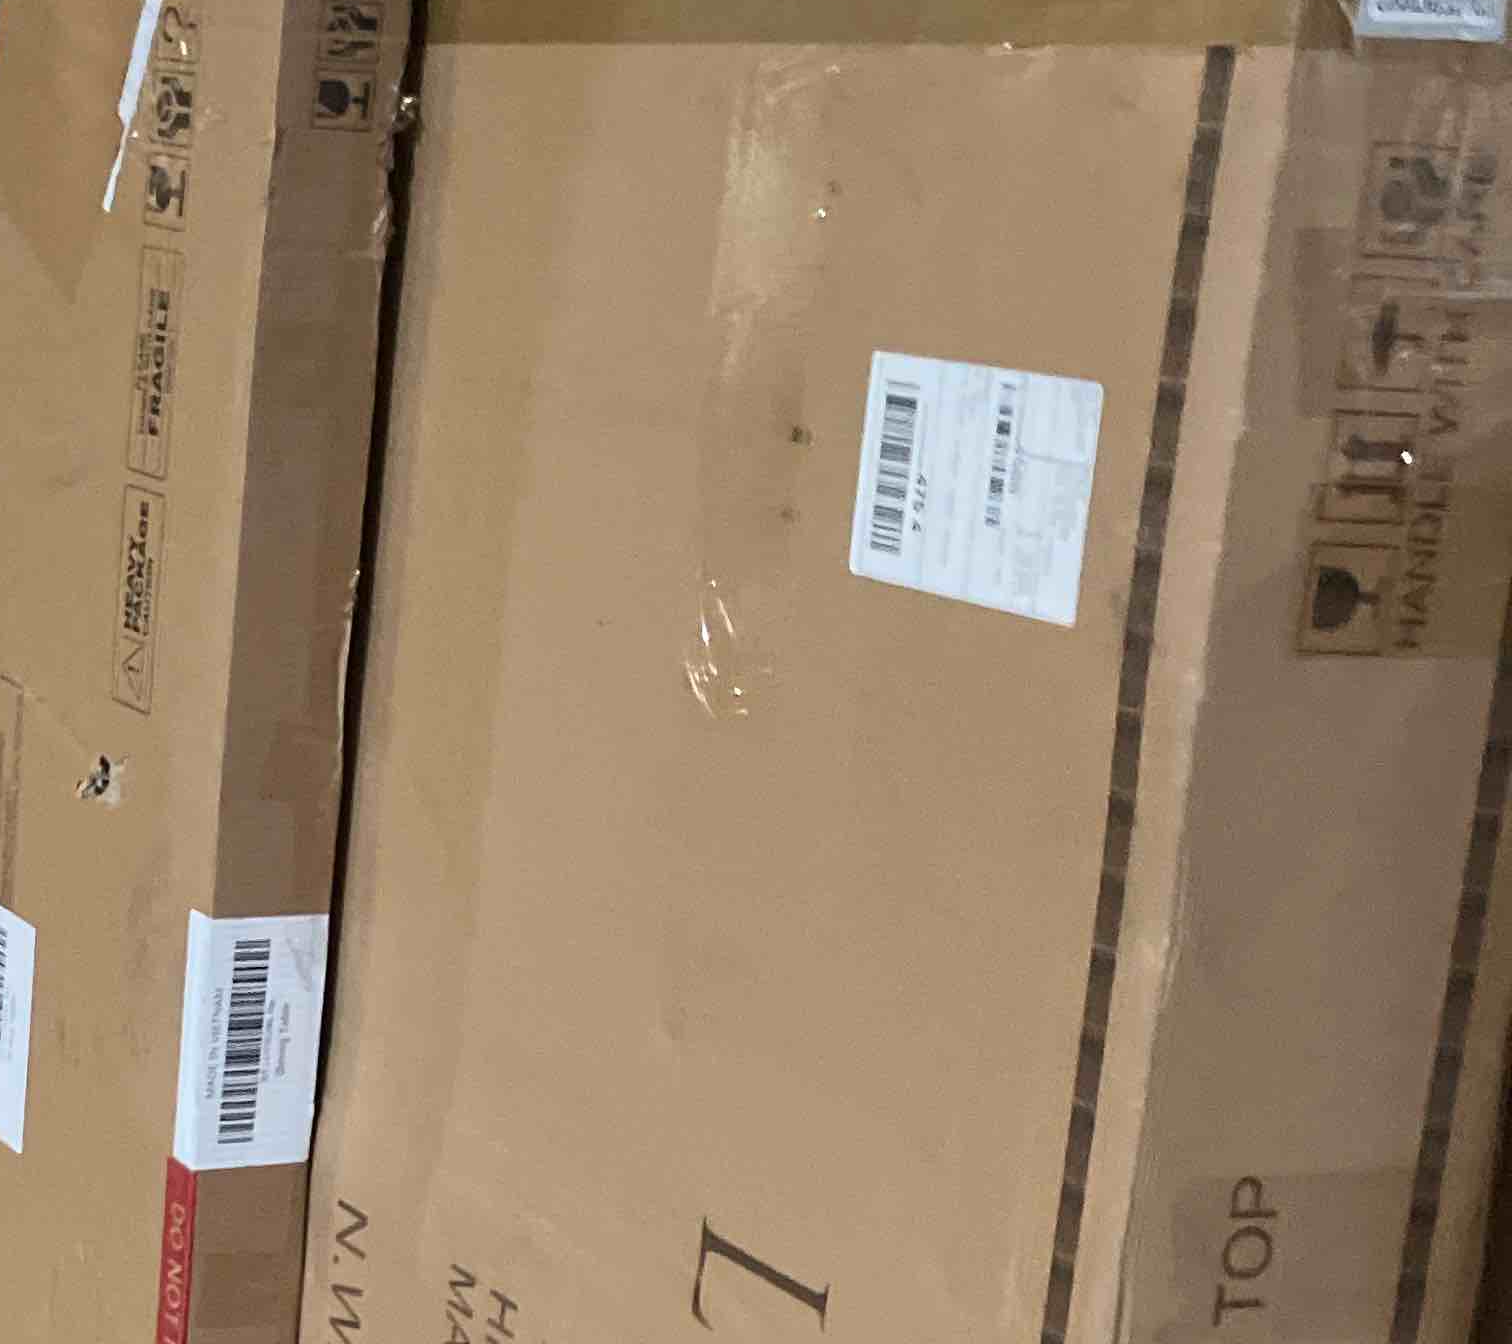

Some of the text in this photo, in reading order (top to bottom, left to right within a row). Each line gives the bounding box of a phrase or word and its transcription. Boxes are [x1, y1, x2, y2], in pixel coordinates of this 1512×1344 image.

[147, 288, 170, 437] FRAGILE
[123, 534, 137, 630] HEAVY
[167, 1200, 186, 1251] DO
[1211, 1176, 1279, 1328] TOP
[165, 1258, 185, 1327] NOT
